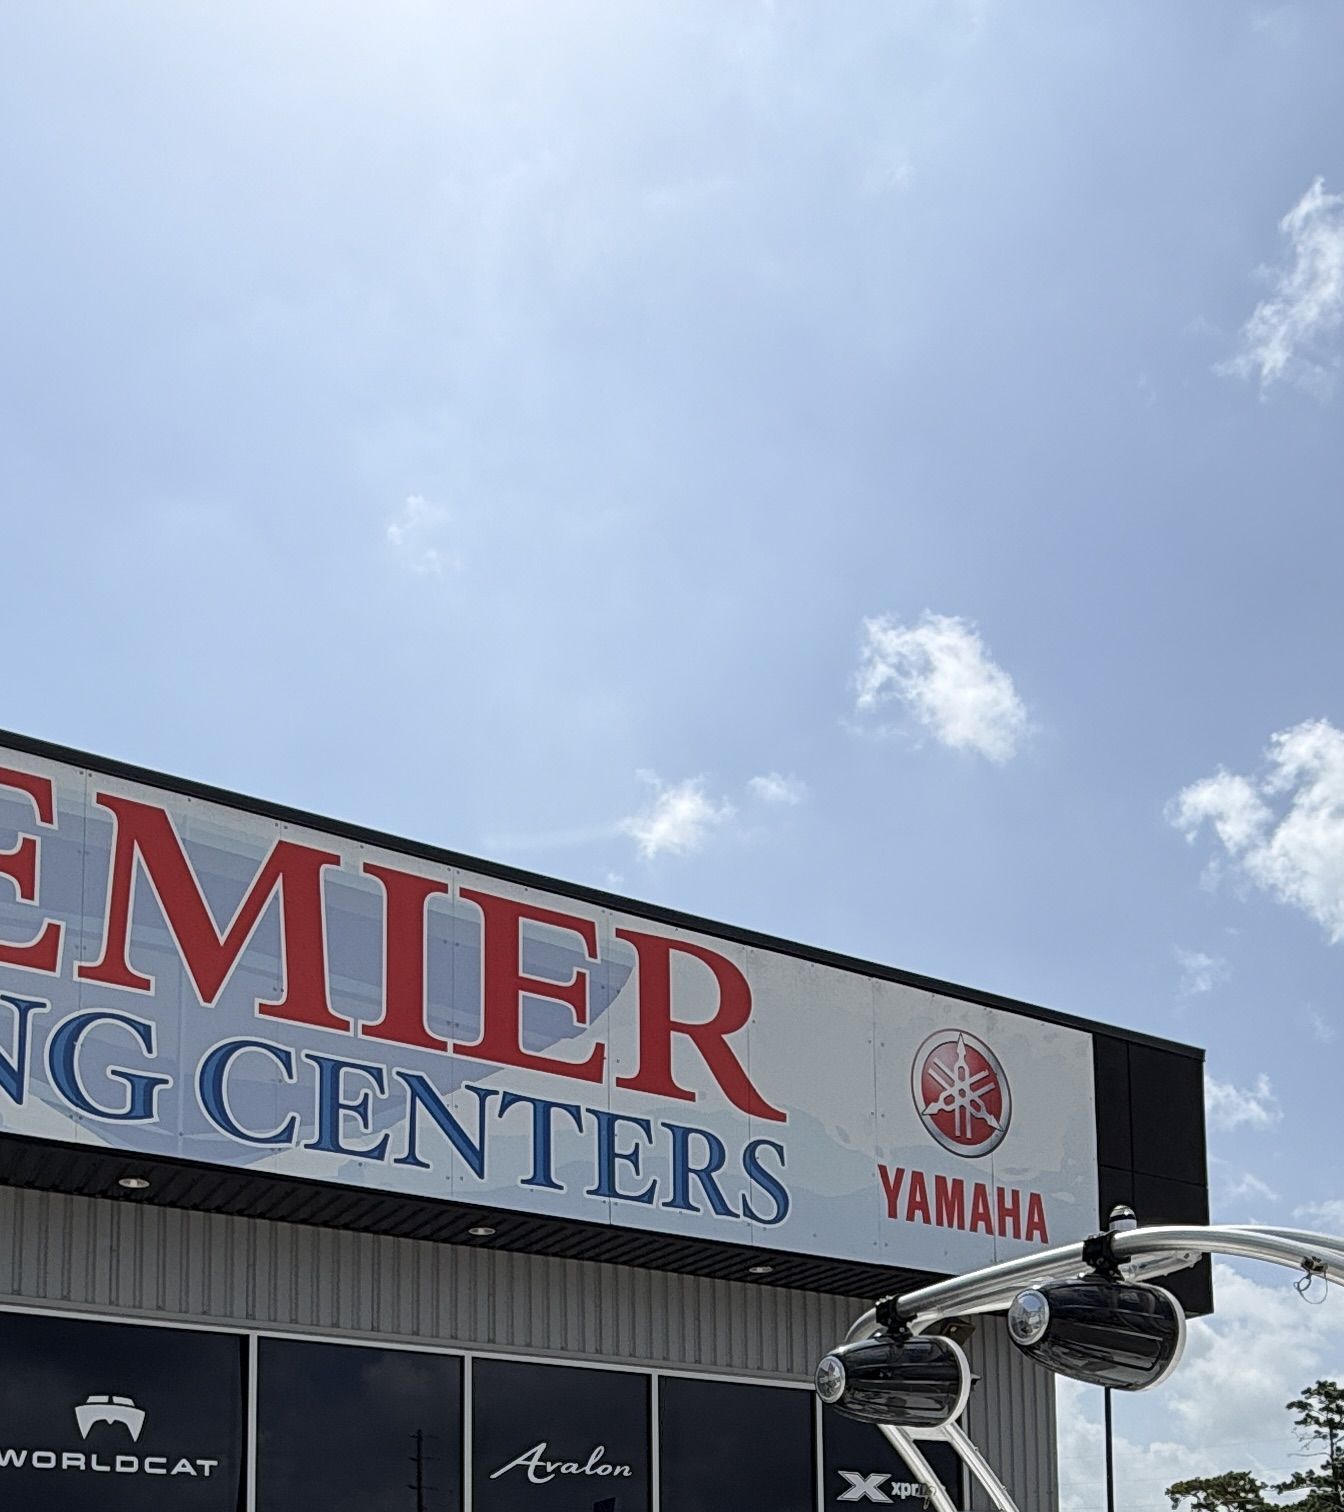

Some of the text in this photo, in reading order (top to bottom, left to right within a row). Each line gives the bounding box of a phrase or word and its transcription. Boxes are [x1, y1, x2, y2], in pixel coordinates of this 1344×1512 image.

[199, 1040, 792, 1226] CENTERS
[877, 1163, 1049, 1244] YAMAHA
[489, 1442, 632, 1484] Avalon
